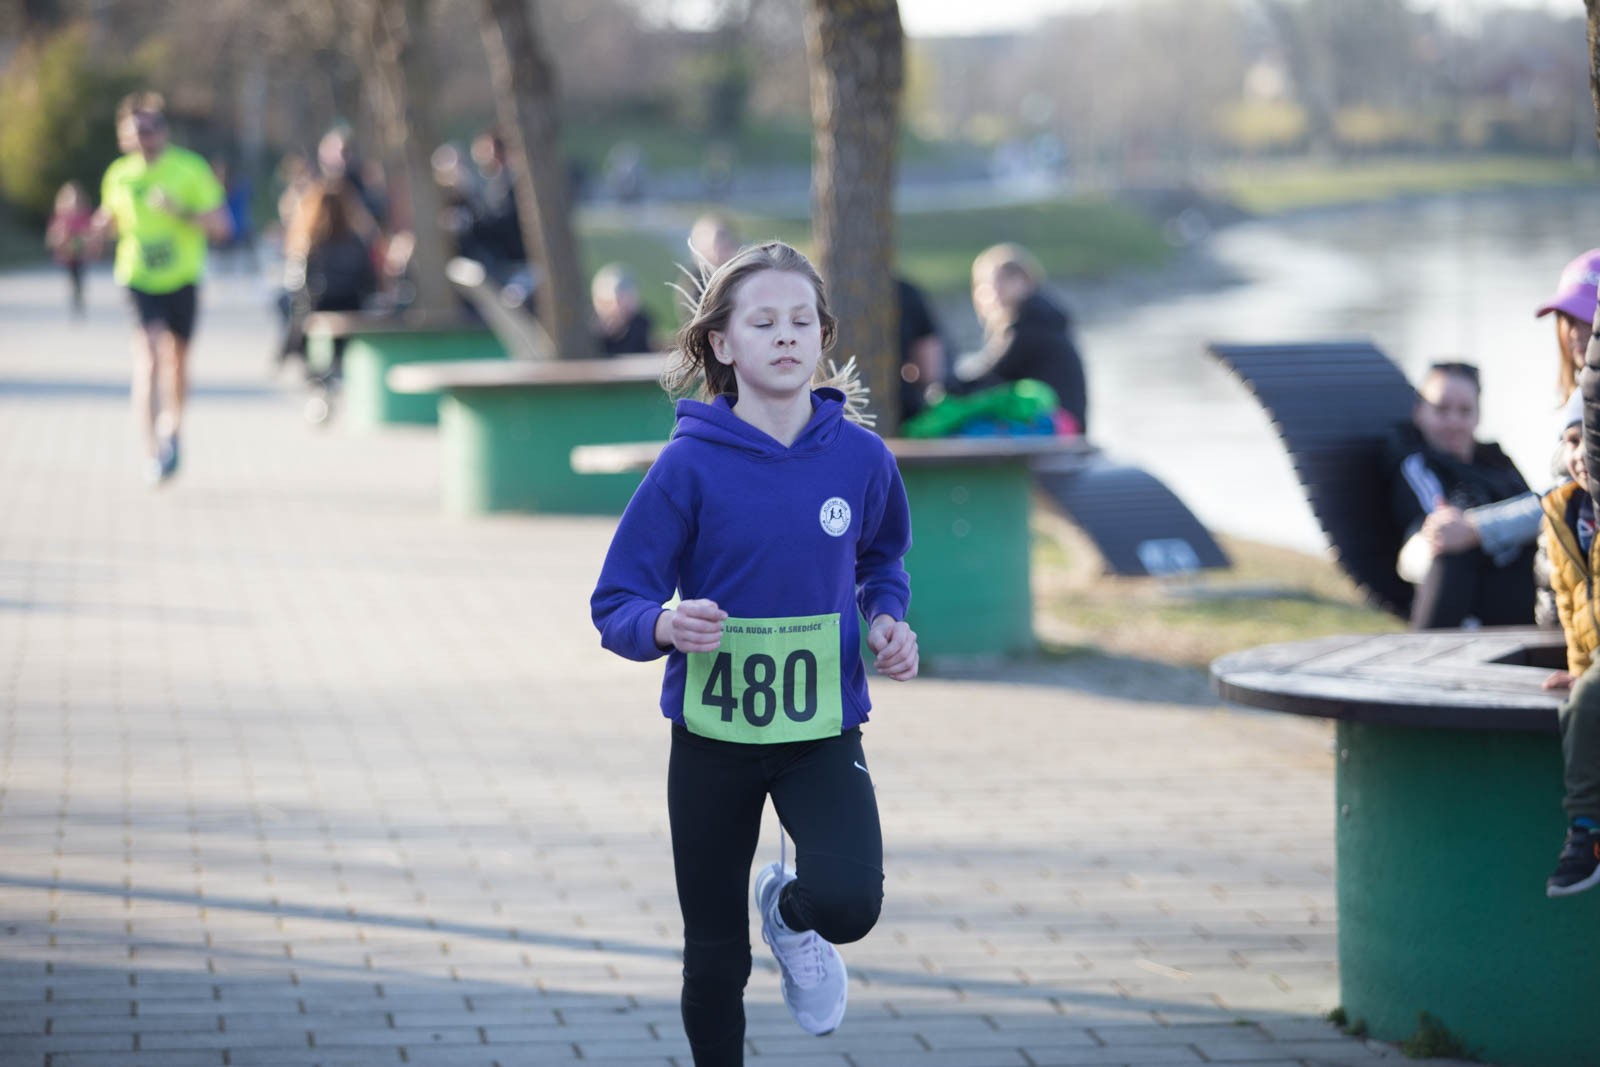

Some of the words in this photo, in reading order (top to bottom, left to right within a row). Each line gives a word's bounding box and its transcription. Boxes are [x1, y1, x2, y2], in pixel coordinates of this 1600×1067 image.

[725, 625, 744, 633] LIGA
[745, 626, 773, 634] RUDAR
[701, 648, 818, 727] 480
